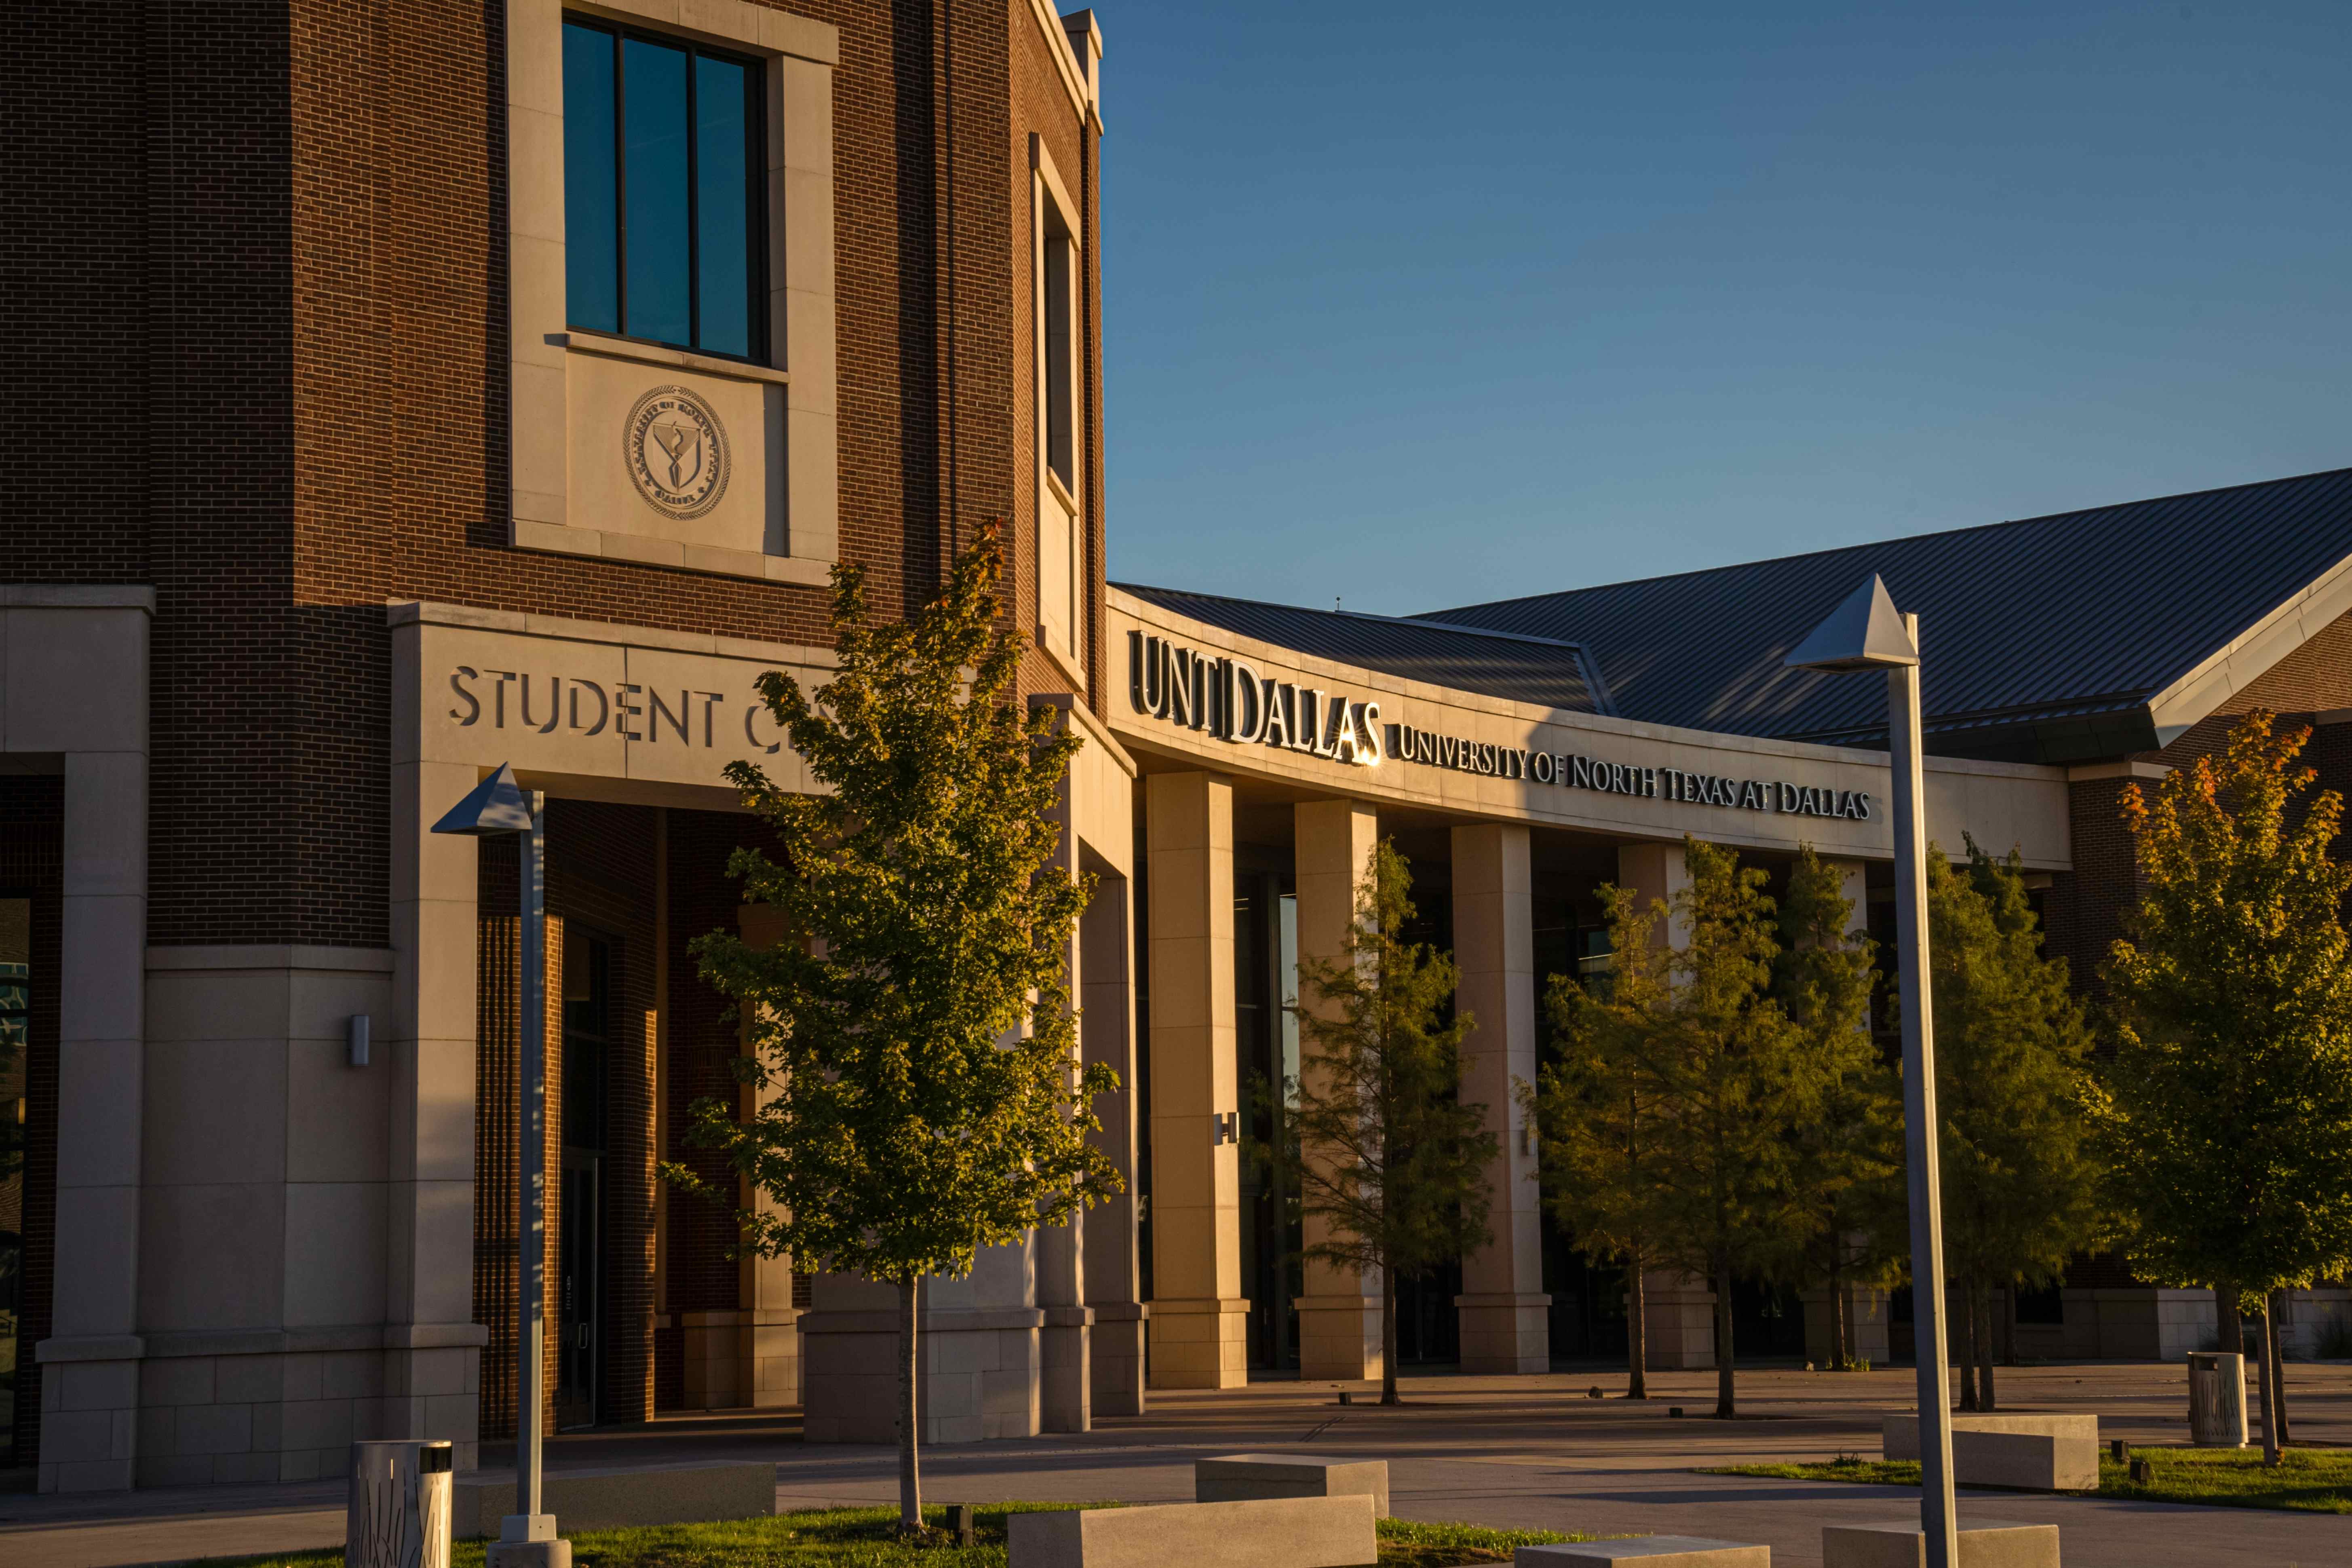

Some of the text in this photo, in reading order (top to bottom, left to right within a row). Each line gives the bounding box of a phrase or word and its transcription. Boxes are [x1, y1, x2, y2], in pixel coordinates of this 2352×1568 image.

[449, 665, 724, 748] STUDENT
[1383, 724, 1870, 820] UNIVERSITY OF NORTH TEXAS AT DALLAS
